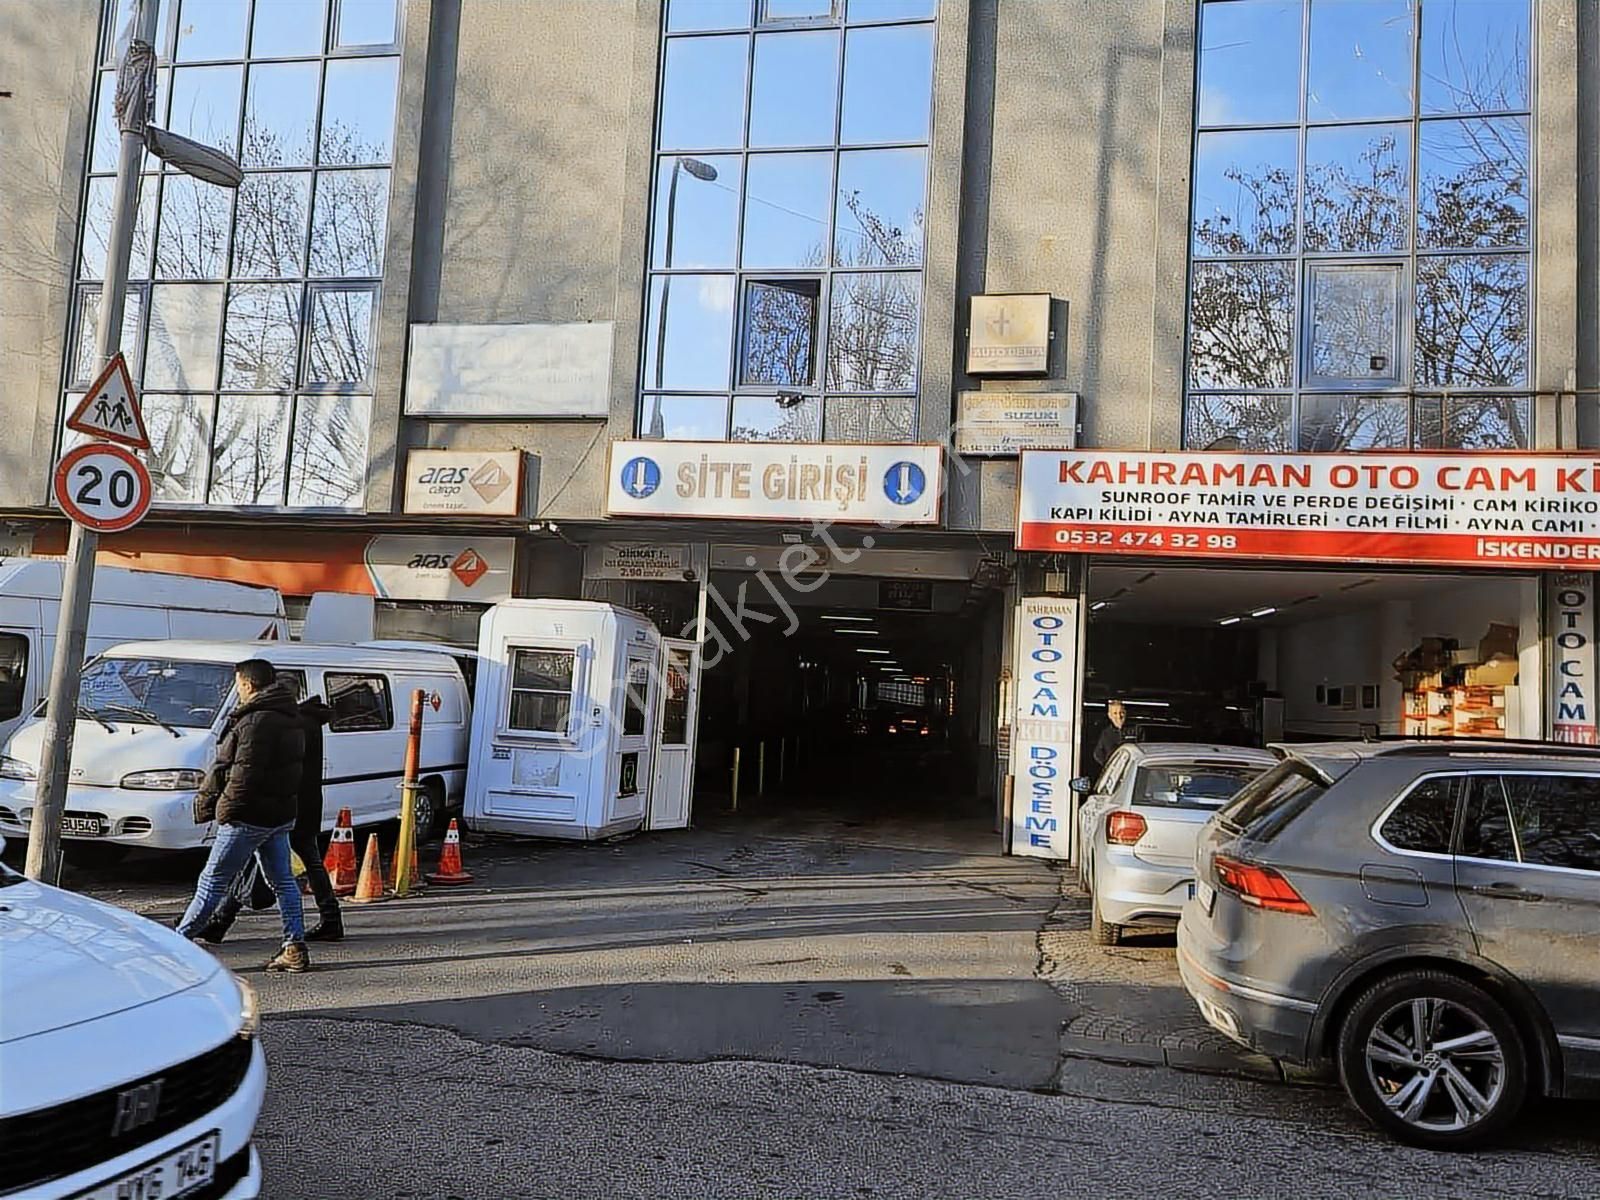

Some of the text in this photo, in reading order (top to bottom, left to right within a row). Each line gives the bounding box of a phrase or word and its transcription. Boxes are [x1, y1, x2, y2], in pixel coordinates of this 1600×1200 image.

[1004, 411, 1058, 420] SUZUKI
[76, 464, 135, 508] 20
[418, 467, 469, 484] aras
[676, 454, 867, 512] SİTE GİRİŞİ
[1058, 460, 1312, 488] KAHRAMAN
[1329, 464, 1419, 490] OTO
[1436, 466, 1536, 491] CAM
[429, 486, 461, 497] cargo
[1101, 490, 1598, 514] SUNROOF TAMİR VE PERDE DEĞİŞİMİ CAM KİRİKO
[1051, 505, 1584, 533] KAPI KİLİDİ AYNA TAMİRLERİ CAM FİLMİ AYNA CAMI
[1055, 530, 1237, 549] 0532 474 32 98
[1477, 537, 1600, 560] İSKENDER
[408, 554, 454, 569] aras
[1027, 605, 1072, 614] KAHRAMAN
[1557, 590, 1586, 650] OTO
[1032, 616, 1064, 663] OTO
[1031, 670, 1059, 717] CAM
[1558, 660, 1586, 720] CAM
[593, 707, 601, 718] P
[1025, 746, 1058, 849] DÖŞEME
